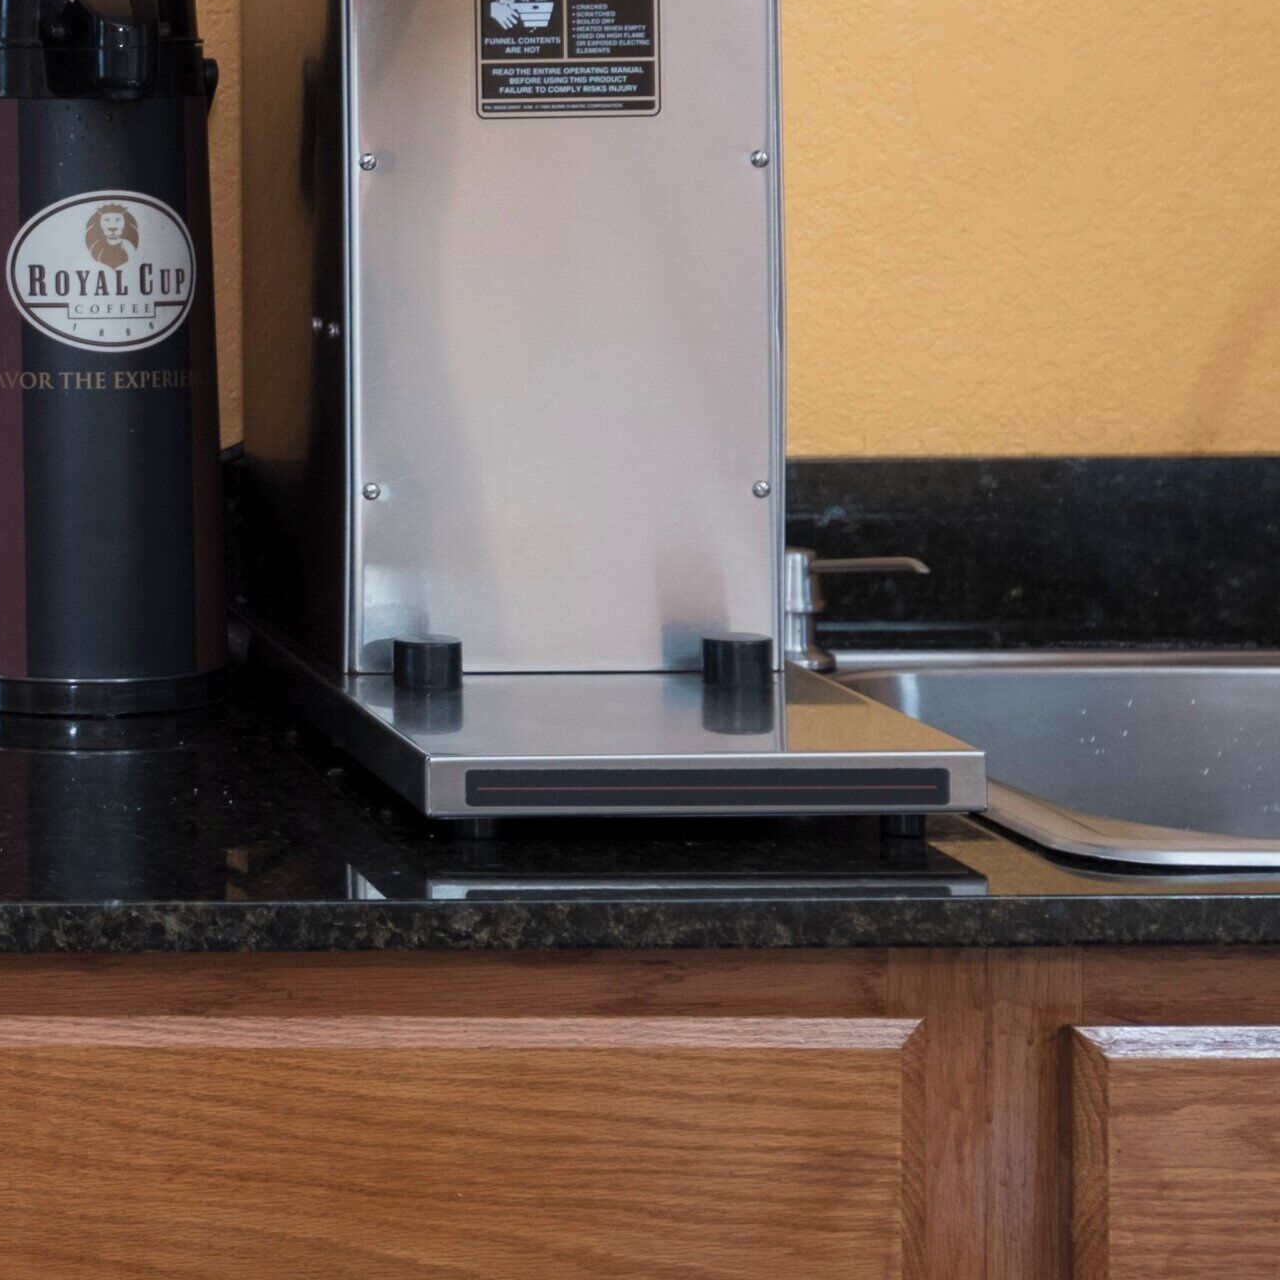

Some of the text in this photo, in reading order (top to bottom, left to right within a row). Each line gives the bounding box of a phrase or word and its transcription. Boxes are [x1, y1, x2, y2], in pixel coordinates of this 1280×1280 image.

[484, 36, 561, 45] FUNNEL CONTENTS
[505, 46, 541, 54] ARE HOT
[492, 68, 515, 76] READ
[533, 67, 562, 75] ENTIRE
[563, 67, 609, 75] OPERATING
[610, 66, 644, 74] MANUAL
[509, 77, 542, 85] BEFORE
[543, 76, 569, 84] USING
[589, 75, 627, 83] PRODUCT
[499, 86, 534, 94] FAILURE
[547, 85, 582, 94] COMPLY
[582, 85, 607, 93] RISKS
[608, 84, 638, 92] INJURY
[28, 263, 185, 297] ROYAL CUP
[74, 303, 152, 315] COFFEE
[59, 371, 107, 390] THE
